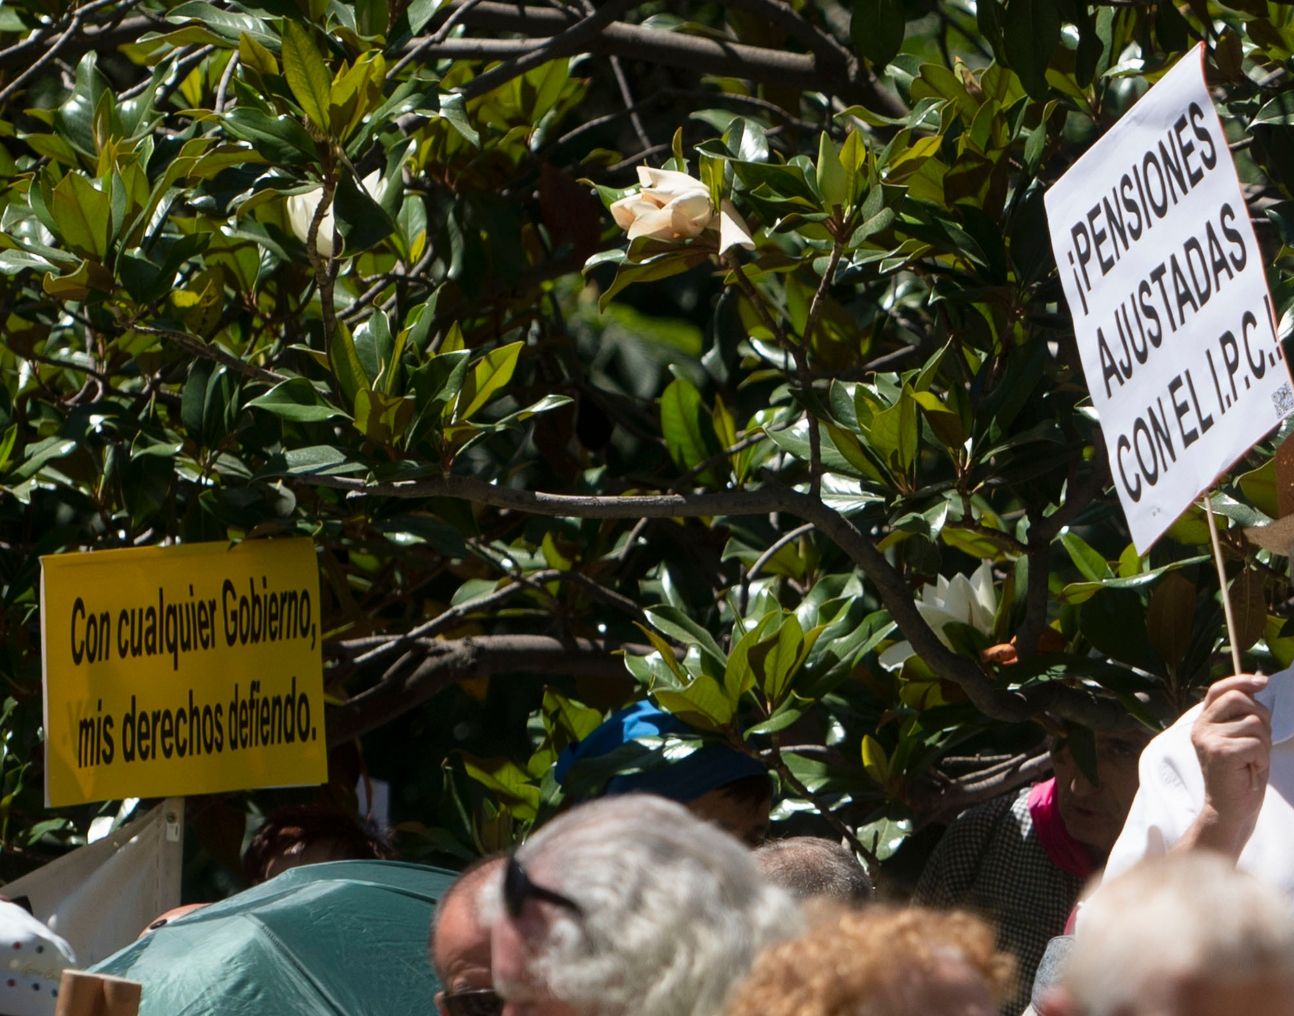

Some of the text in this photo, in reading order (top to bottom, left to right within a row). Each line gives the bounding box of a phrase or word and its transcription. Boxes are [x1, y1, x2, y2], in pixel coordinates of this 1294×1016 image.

[1067, 101, 1218, 316] ¡PENSIONES
[1095, 202, 1248, 400] AJUSTADAS
[1116, 401, 1176, 503] CON
[1167, 369, 1214, 450] EL
[70, 575, 317, 671] Con cualquier Gobierno,
[78, 676, 317, 769] mis derechos defiendo.
